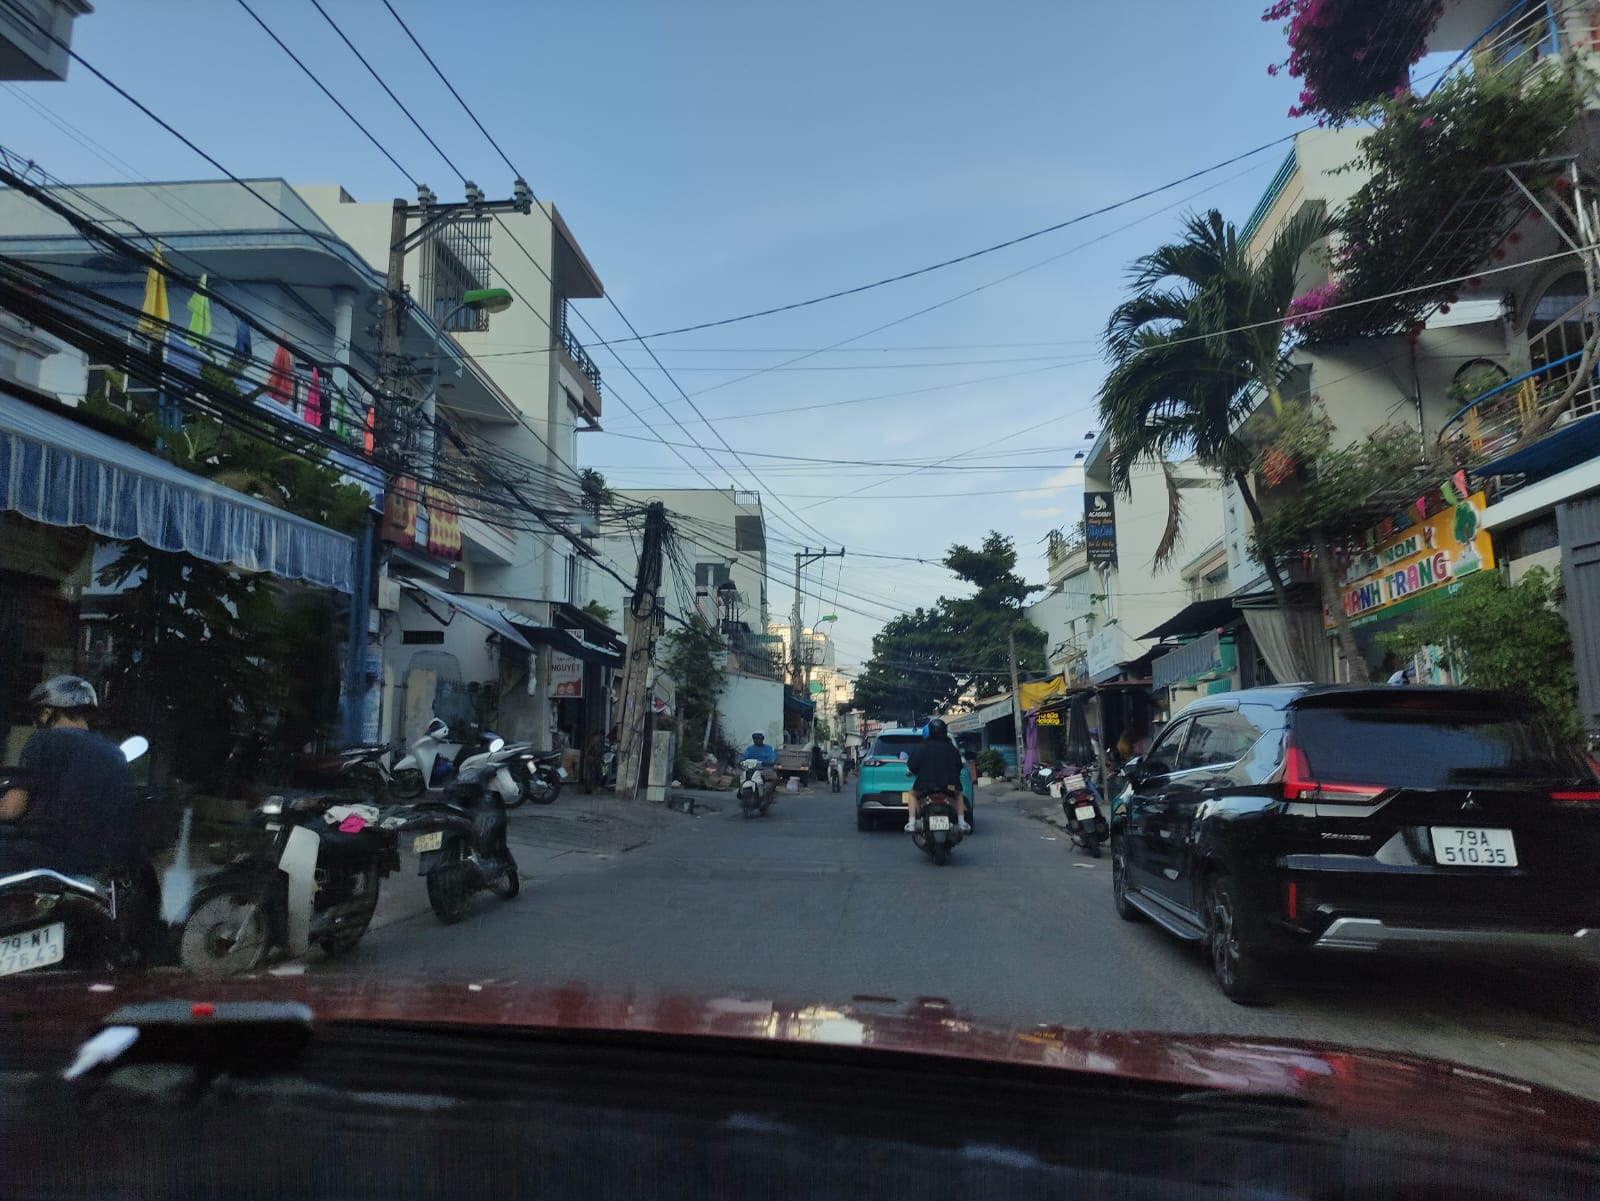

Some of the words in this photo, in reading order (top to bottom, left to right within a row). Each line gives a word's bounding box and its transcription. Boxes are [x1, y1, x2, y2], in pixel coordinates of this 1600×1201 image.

[1384, 552, 1448, 599] TRANG
[1455, 830, 1490, 846] 79A
[1445, 846, 1507, 864] 510.35
